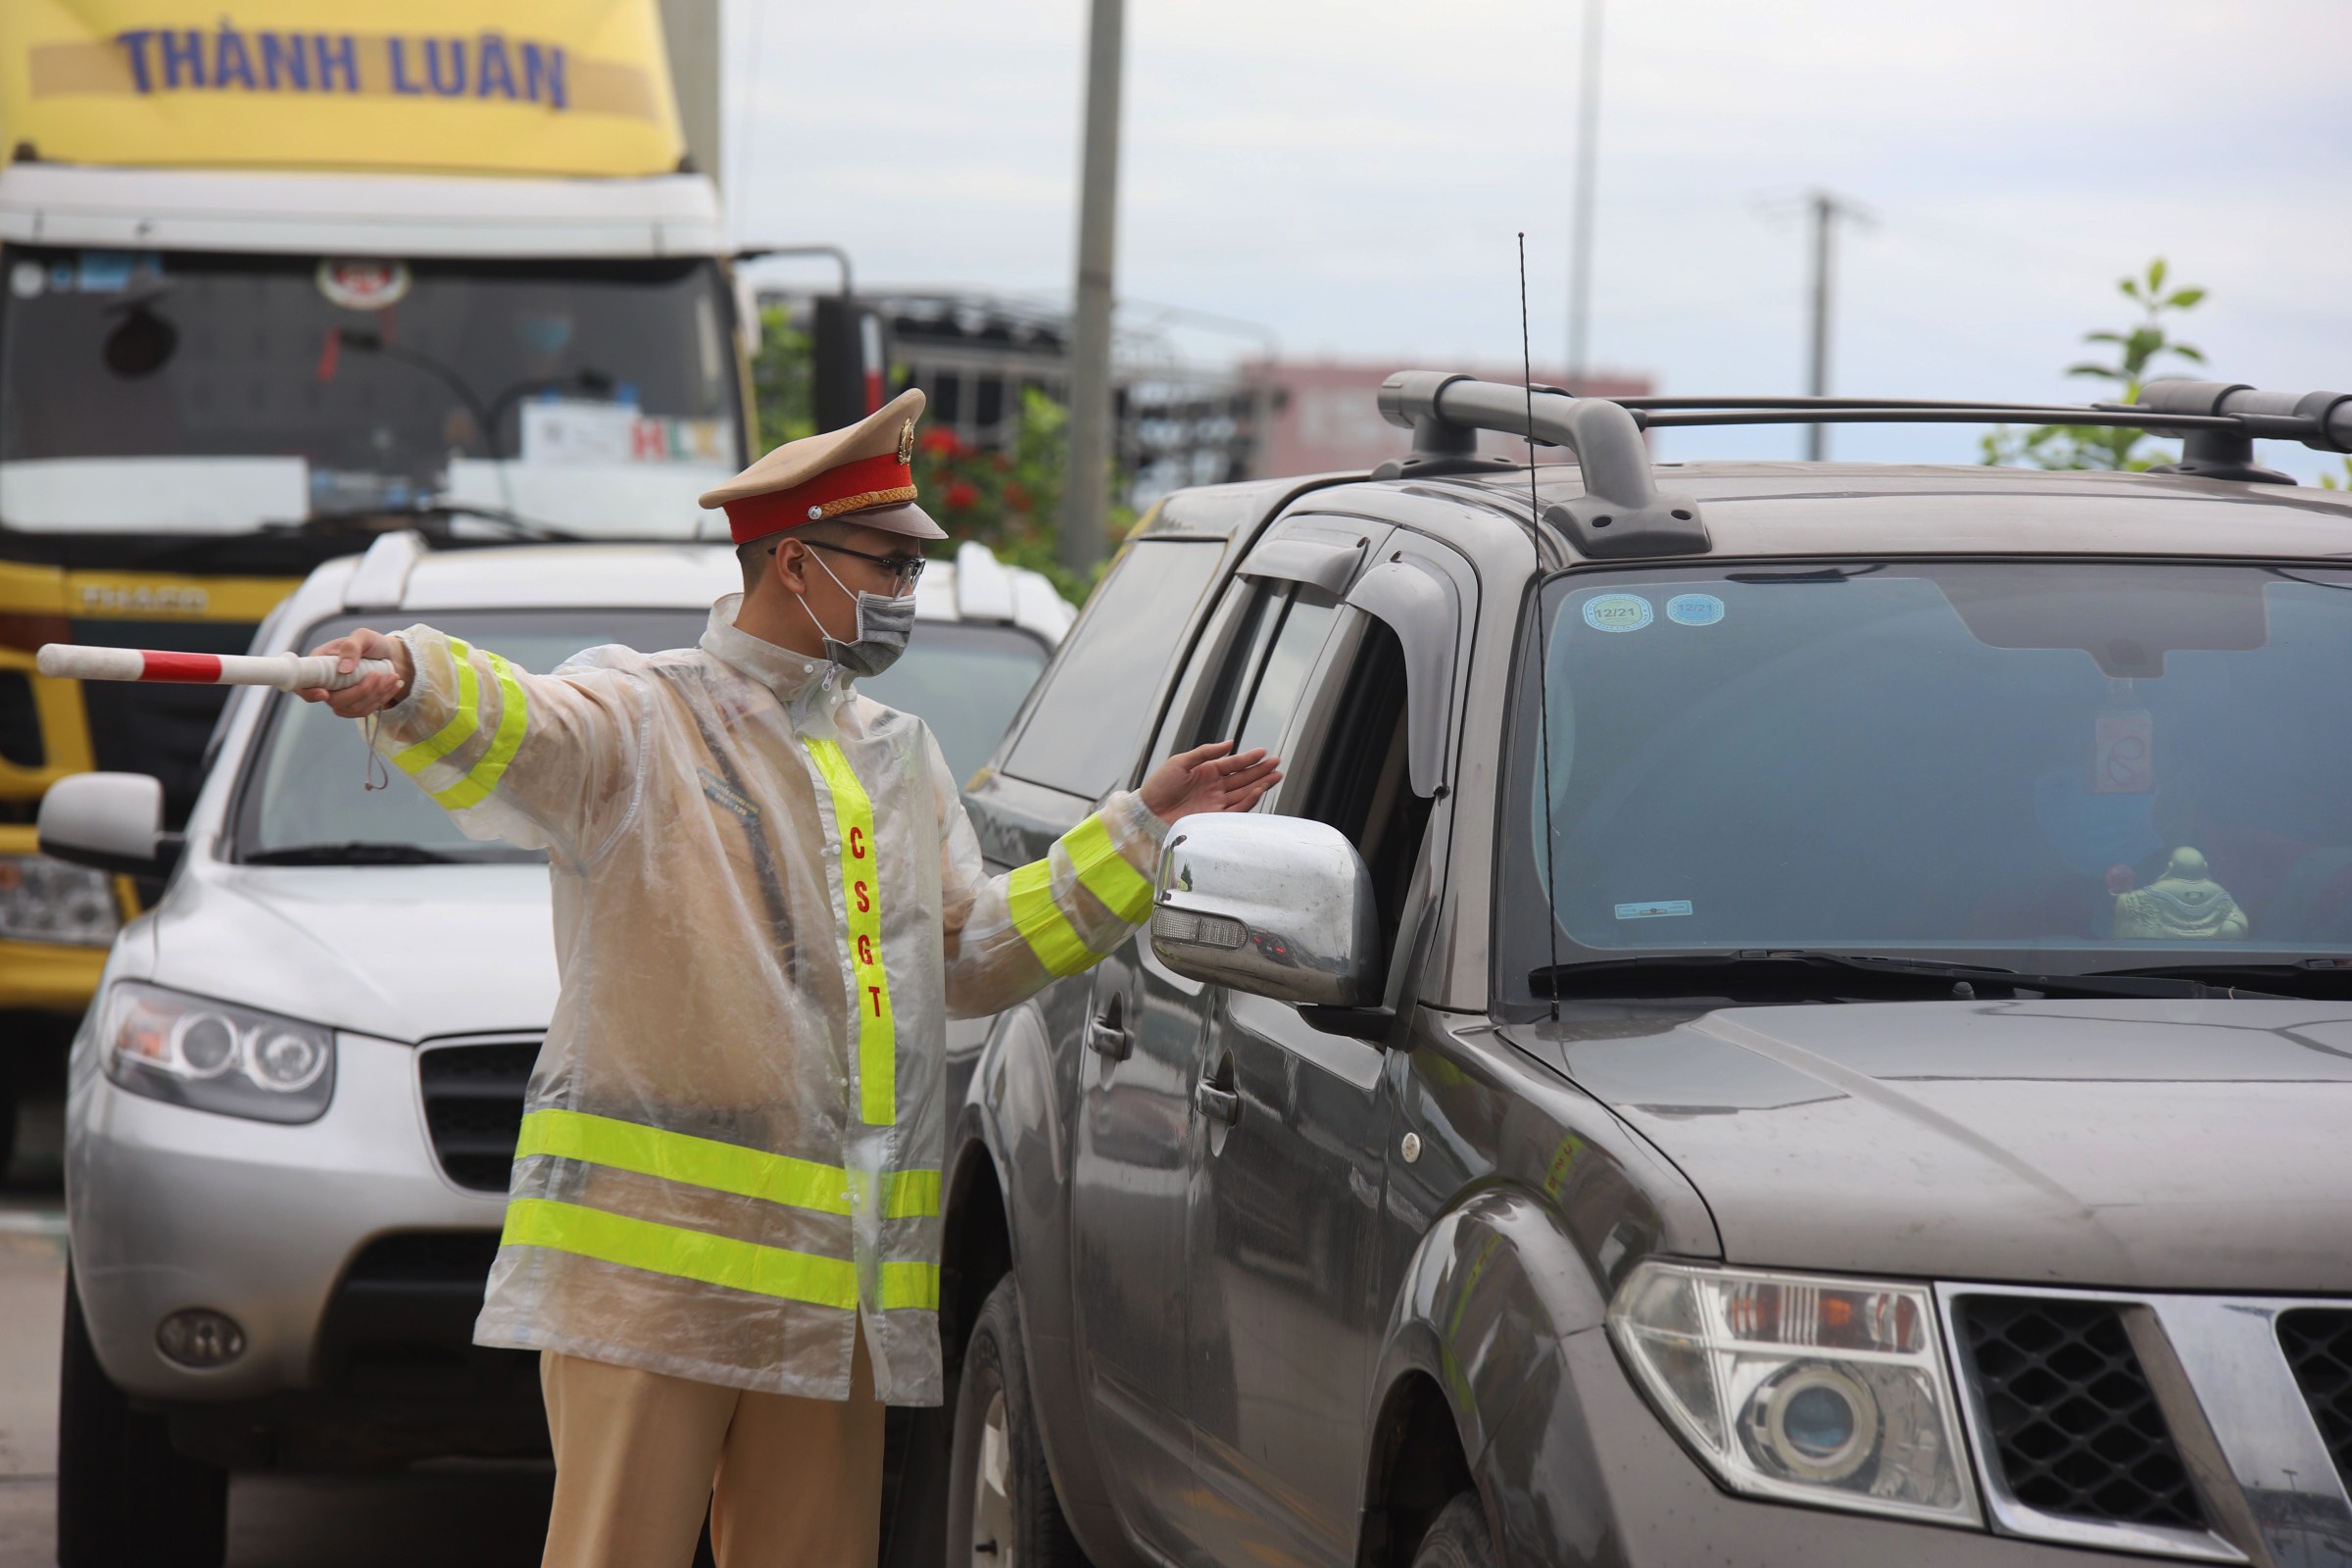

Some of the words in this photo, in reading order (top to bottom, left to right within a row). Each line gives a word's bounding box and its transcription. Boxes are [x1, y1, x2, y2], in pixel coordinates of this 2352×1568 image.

[116, 14, 360, 95] THÀNH
[386, 27, 569, 111] LUÂN
[1595, 608, 1636, 618] 12/21
[1679, 604, 1713, 612] 12/21
